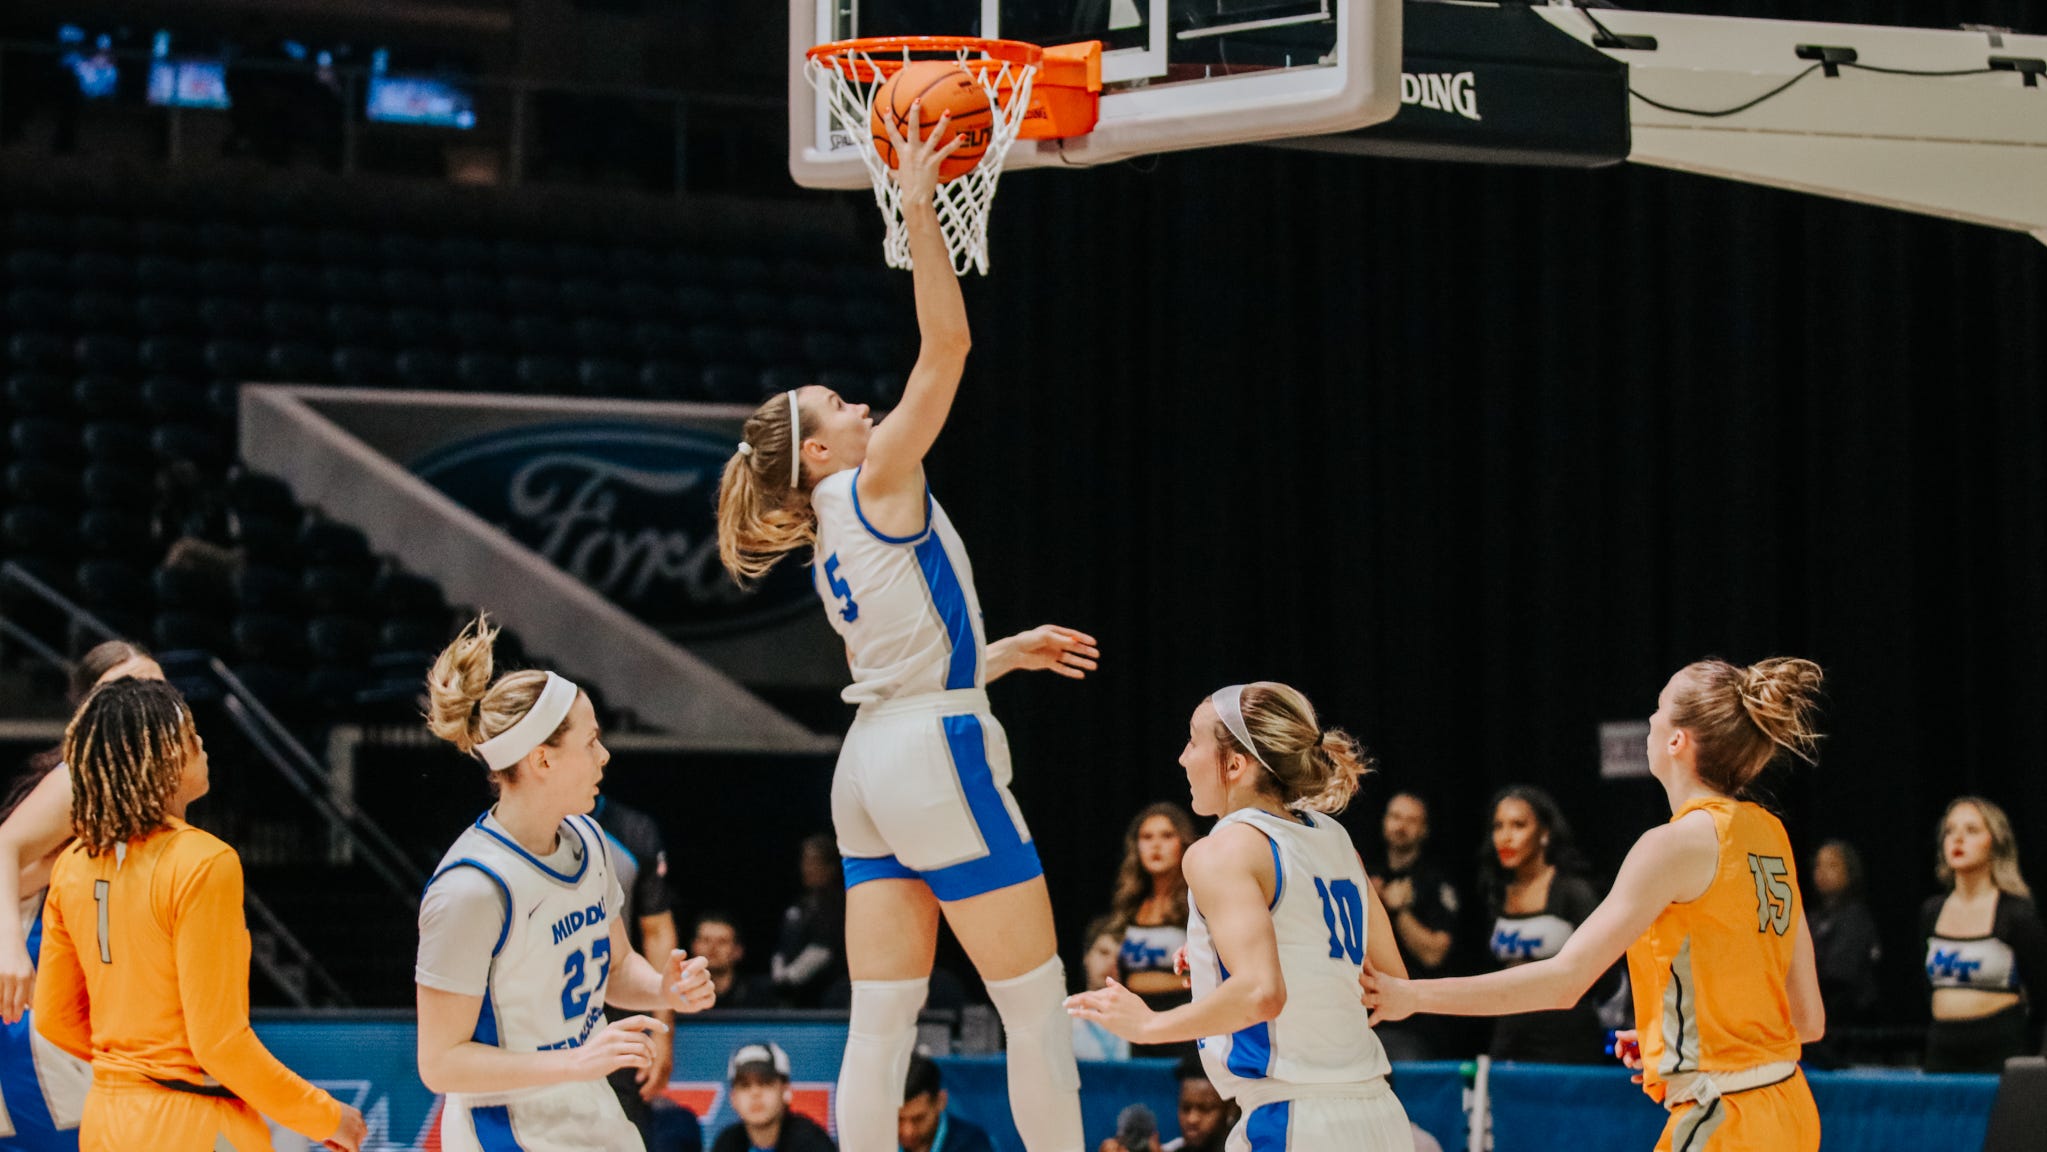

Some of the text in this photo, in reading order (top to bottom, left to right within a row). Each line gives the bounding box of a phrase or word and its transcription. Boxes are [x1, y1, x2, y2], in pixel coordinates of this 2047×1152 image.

[823, 551, 859, 624] 5
[93, 878, 113, 965] 1
[1313, 876, 1365, 966] 10
[1747, 852, 1793, 937] 15
